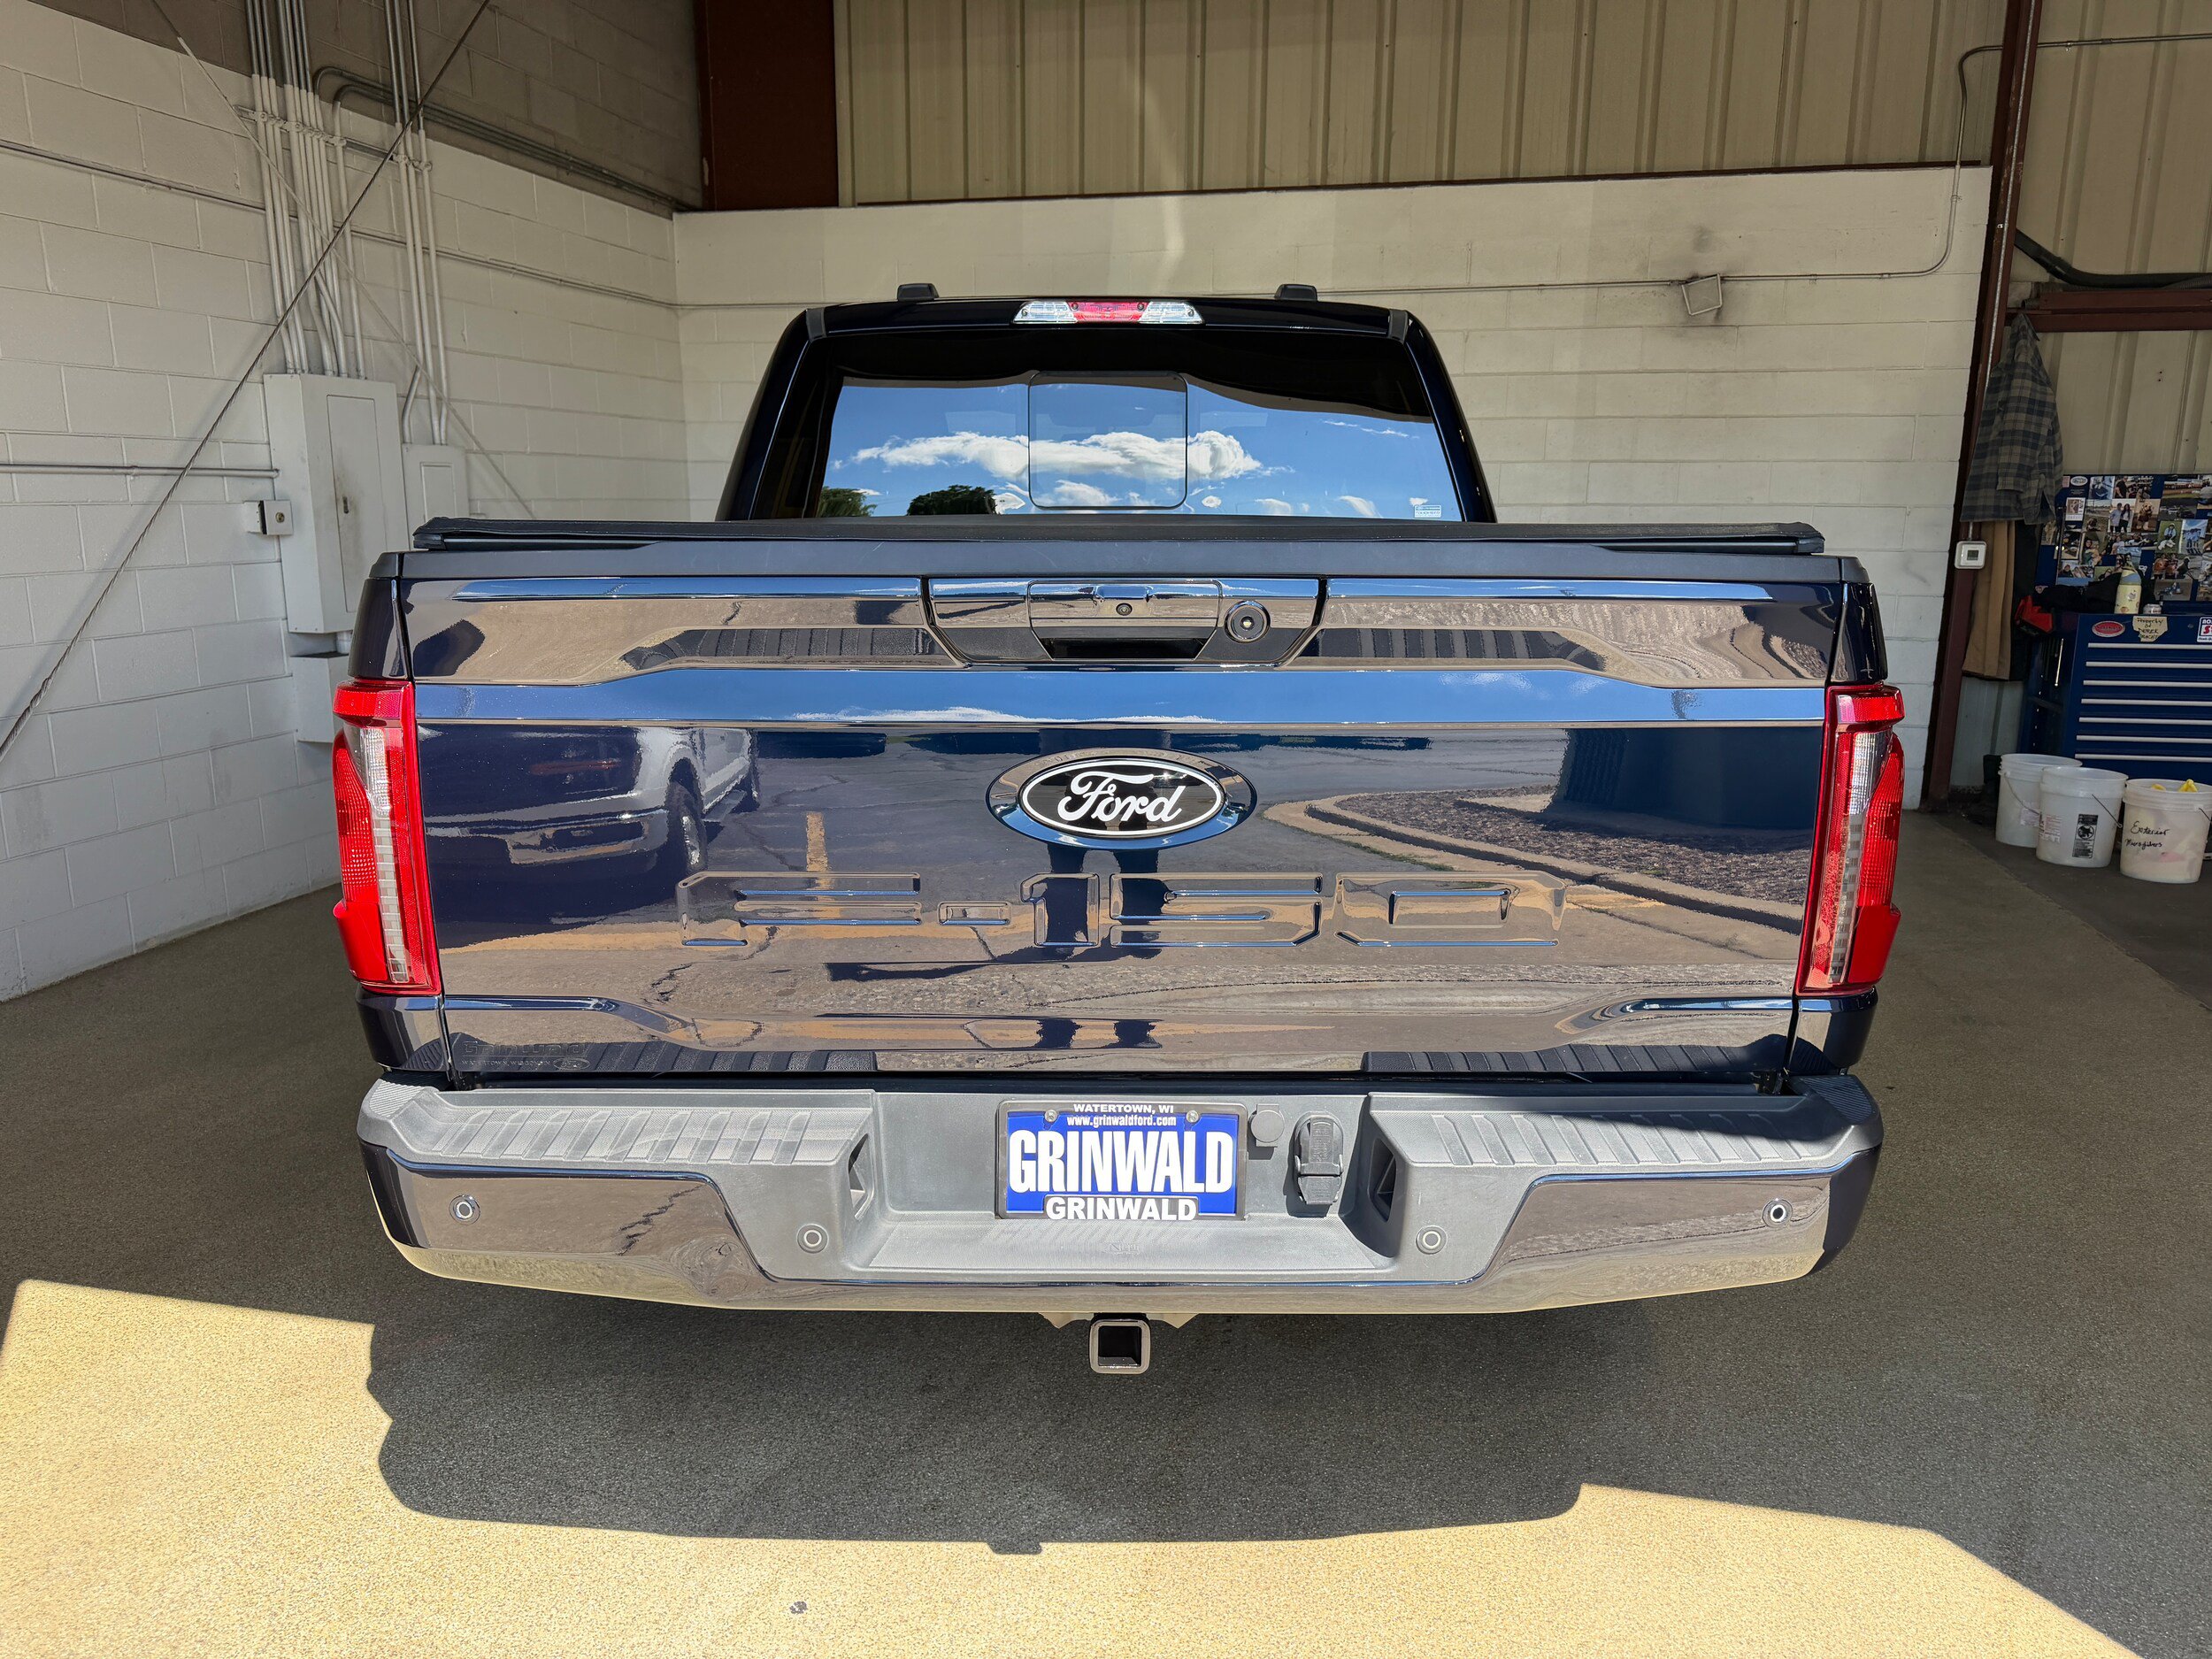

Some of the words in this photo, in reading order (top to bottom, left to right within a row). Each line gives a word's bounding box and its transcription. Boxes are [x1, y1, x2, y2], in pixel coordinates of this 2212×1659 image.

[1056, 771, 1187, 823] Ford
[2130, 820, 2170, 835] Exterior
[678, 872, 1564, 948] F-150
[1066, 1114, 1177, 1128] www.grinwaldford.com
[1073, 1104, 1156, 1115] WATERTOWN,
[1158, 1104, 1174, 1114] WI
[1009, 1129, 1234, 1194] GRINWALD
[1045, 1196, 1197, 1221] GRINWALD
